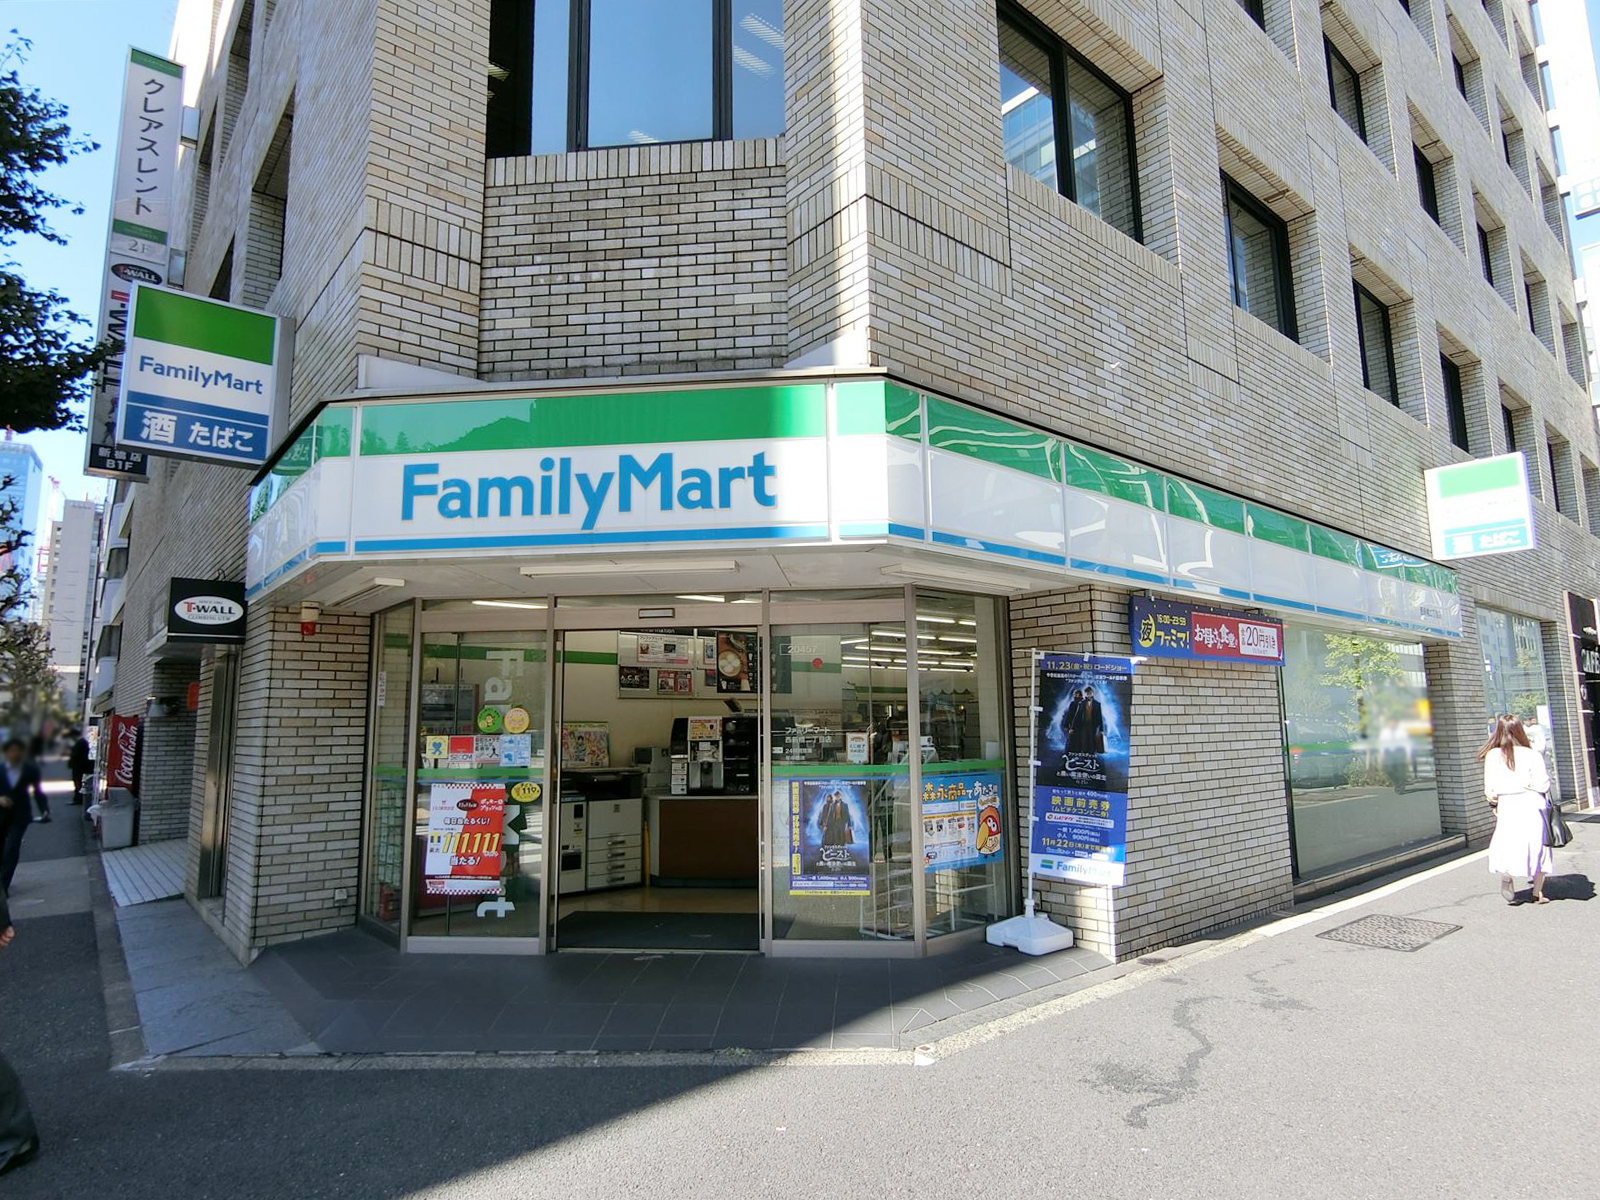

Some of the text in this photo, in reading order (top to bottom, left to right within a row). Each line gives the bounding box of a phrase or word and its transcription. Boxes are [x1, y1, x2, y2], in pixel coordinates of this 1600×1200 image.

[135, 79, 165, 215] クレアスレント
[128, 239, 151, 254] 2F
[139, 356, 263, 395] FamilyMart
[140, 410, 177, 444] 酒
[188, 422, 254, 452] たばこ
[105, 459, 135, 471] B1F
[401, 451, 777, 531] FamilyMart
[1094, 664, 1128, 672] ロードショー
[1062, 754, 1102, 772] ビースト
[449, 856, 480, 866] 当たる!
